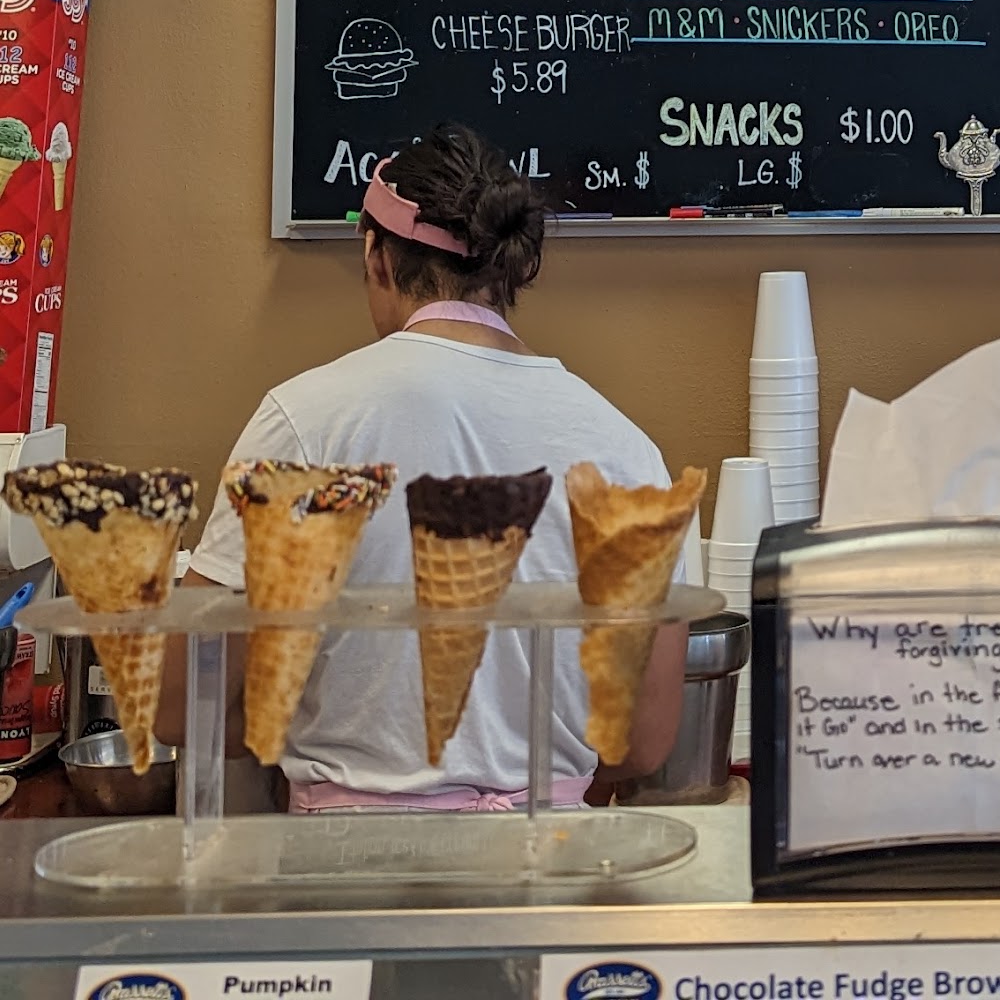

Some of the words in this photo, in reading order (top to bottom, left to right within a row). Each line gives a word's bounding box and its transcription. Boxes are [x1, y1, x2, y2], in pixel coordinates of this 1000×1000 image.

[650, 8, 725, 39] M&M
[746, 6, 870, 41] SNICKERS
[894, 11, 959, 42] OREO
[490, 59, 567, 104] $5.89
[659, 97, 804, 147] SNACKS
[840, 107, 914, 144] $1.00
[35, 292, 62, 313] CUPS
[807, 615, 878, 649] Why
[896, 619, 947, 638] are
[794, 685, 901, 714] Because
[909, 682, 934, 705] in
[942, 682, 984, 705] the
[865, 715, 907, 736] and
[914, 717, 937, 735] in
[943, 714, 989, 735] the
[949, 753, 996, 769] new
[222, 975, 332, 998] Pumpkin
[675, 974, 824, 1000] Chocolate
[835, 971, 924, 1000] Fudge
